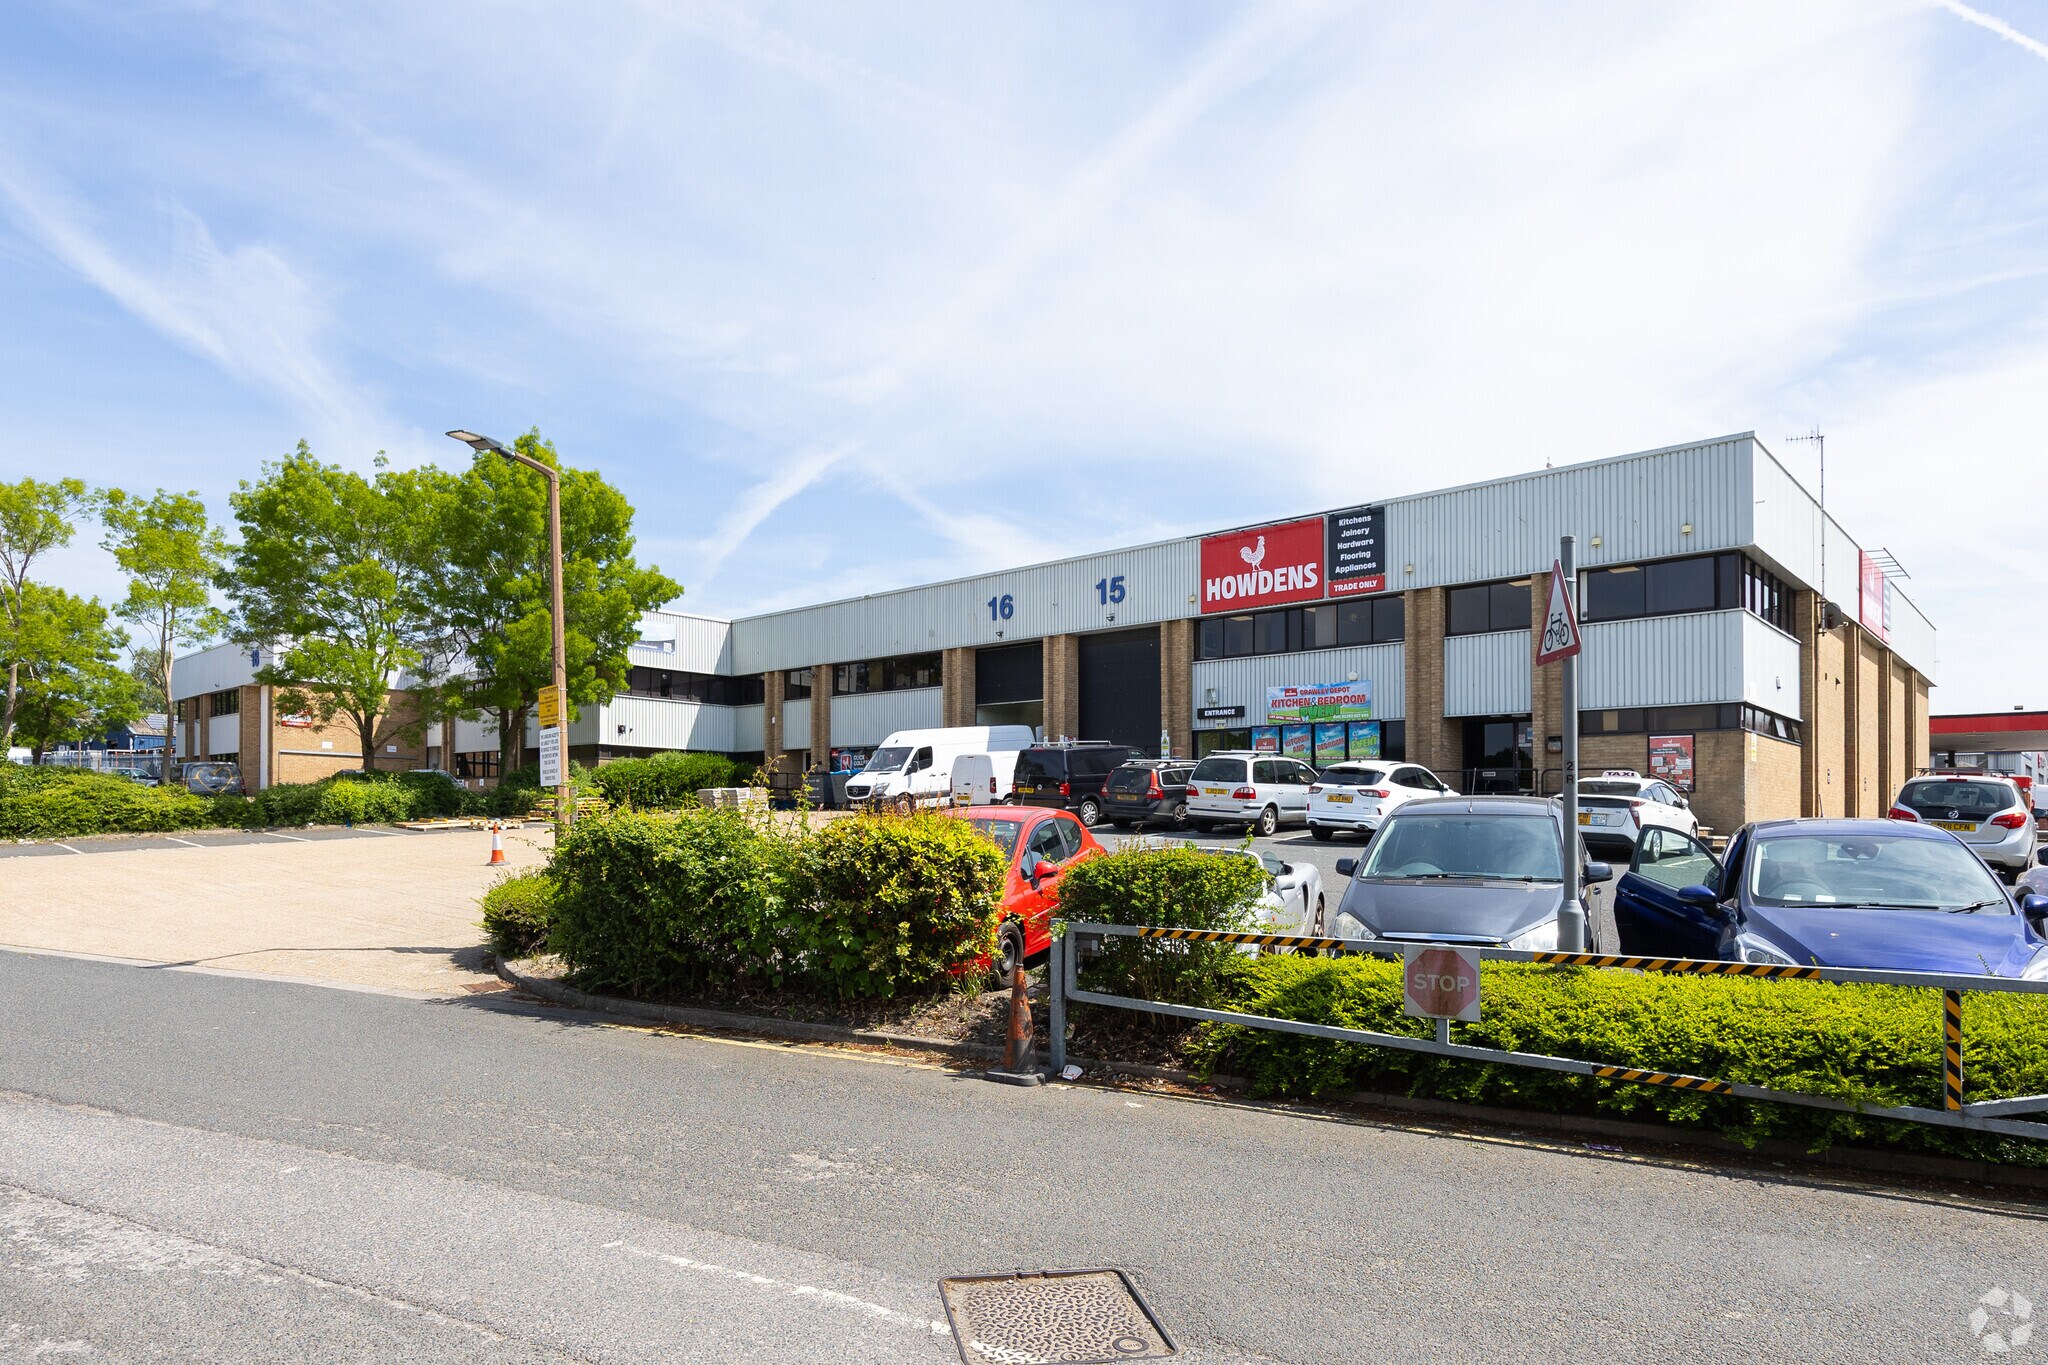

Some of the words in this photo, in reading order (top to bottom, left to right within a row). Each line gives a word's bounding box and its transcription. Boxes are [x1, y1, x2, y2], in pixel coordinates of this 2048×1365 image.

[1339, 515, 1372, 527] Kitchens
[1341, 527, 1370, 538] Joinery
[1337, 538, 1374, 550] Hardware
[1340, 550, 1371, 561] Flooring
[1335, 561, 1377, 575] Appliances
[1206, 562, 1318, 602] HOWDENS
[1334, 583, 1358, 592] TRADE
[1358, 580, 1378, 589] ONLY
[1096, 575, 1126, 606] 15
[987, 594, 1014, 621] 16
[1300, 688, 1329, 696] CRAWLEY
[1329, 686, 1350, 694] DEPOT
[1204, 708, 1236, 717] ENTRANCE
[1298, 704, 1341, 719] EVENT
[1284, 734, 1310, 748] KITCHEN
[1316, 737, 1345, 752] BEDROOM
[1350, 735, 1378, 750] EVENT
[1292, 744, 1306, 754] AND
[1566, 761, 1573, 770] 2
[1566, 775, 1574, 783] R
[1413, 973, 1470, 993] STOP
